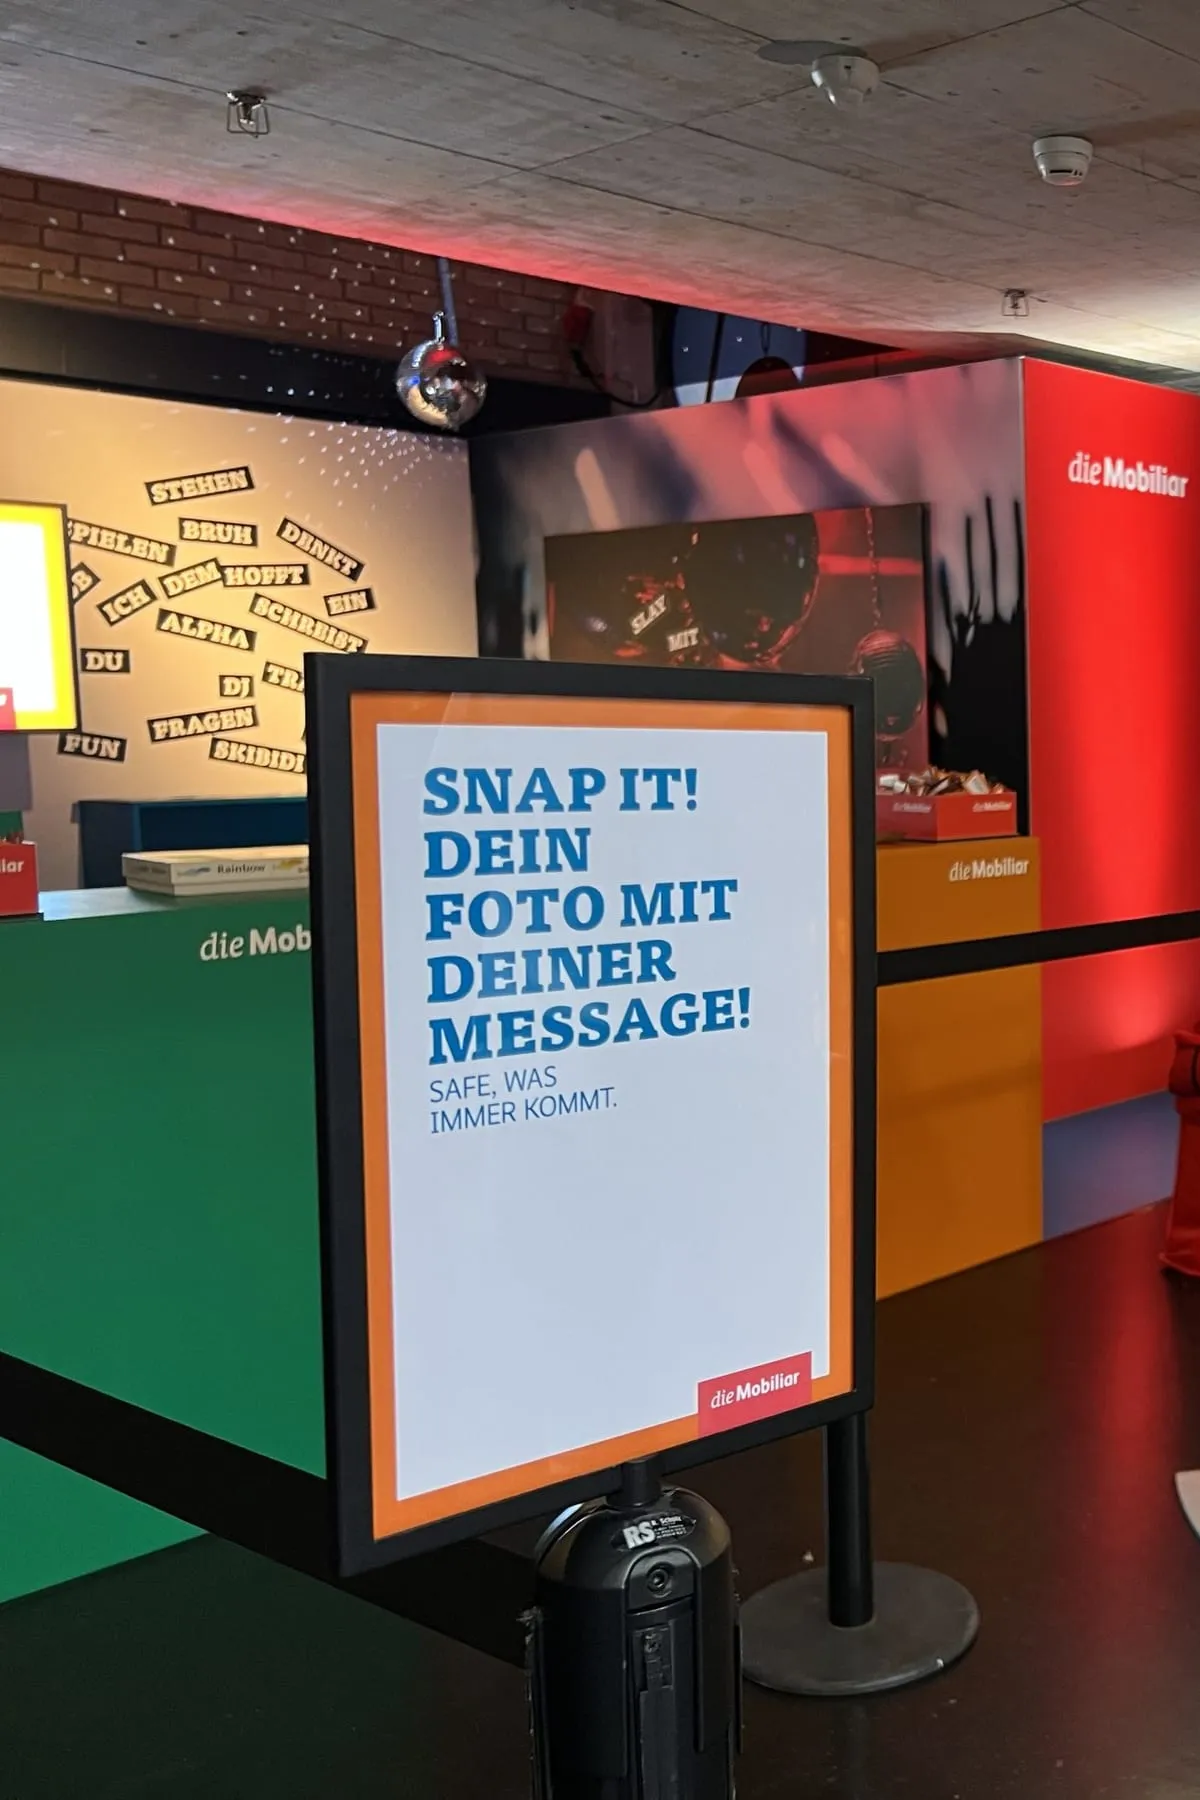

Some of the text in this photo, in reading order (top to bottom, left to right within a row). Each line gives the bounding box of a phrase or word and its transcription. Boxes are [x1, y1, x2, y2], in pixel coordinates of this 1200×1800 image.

[151, 470, 249, 503] STEHEN
[1068, 451, 1189, 497] die Mobiliar
[182, 520, 253, 544] BRUH
[281, 522, 358, 575] DENKT
[163, 562, 222, 596] DEM
[224, 566, 304, 586] HOFFT
[102, 586, 152, 621] ICH
[328, 591, 368, 615] EIN
[160, 612, 250, 649] ALPHA
[667, 627, 699, 652] MIT
[85, 652, 123, 671] DU
[222, 676, 250, 697] DJ
[152, 710, 254, 741] FRAGEN
[64, 734, 121, 759] FUN
[423, 767, 698, 816] SNAP IT!
[217, 864, 266, 874] Rainbow
[424, 827, 591, 878] DEIN
[949, 857, 1029, 882] die Mobiliar
[425, 879, 738, 941] FOTO MIT
[200, 932, 244, 961] die
[427, 939, 676, 1003] DEINER
[429, 987, 751, 1065] MESSAGE!
[430, 1065, 557, 1103] SAFE, WAS
[431, 1086, 618, 1134] IMMER KOMMT.
[711, 1372, 800, 1409] die Mobiliar
[623, 1521, 656, 1549] RS
